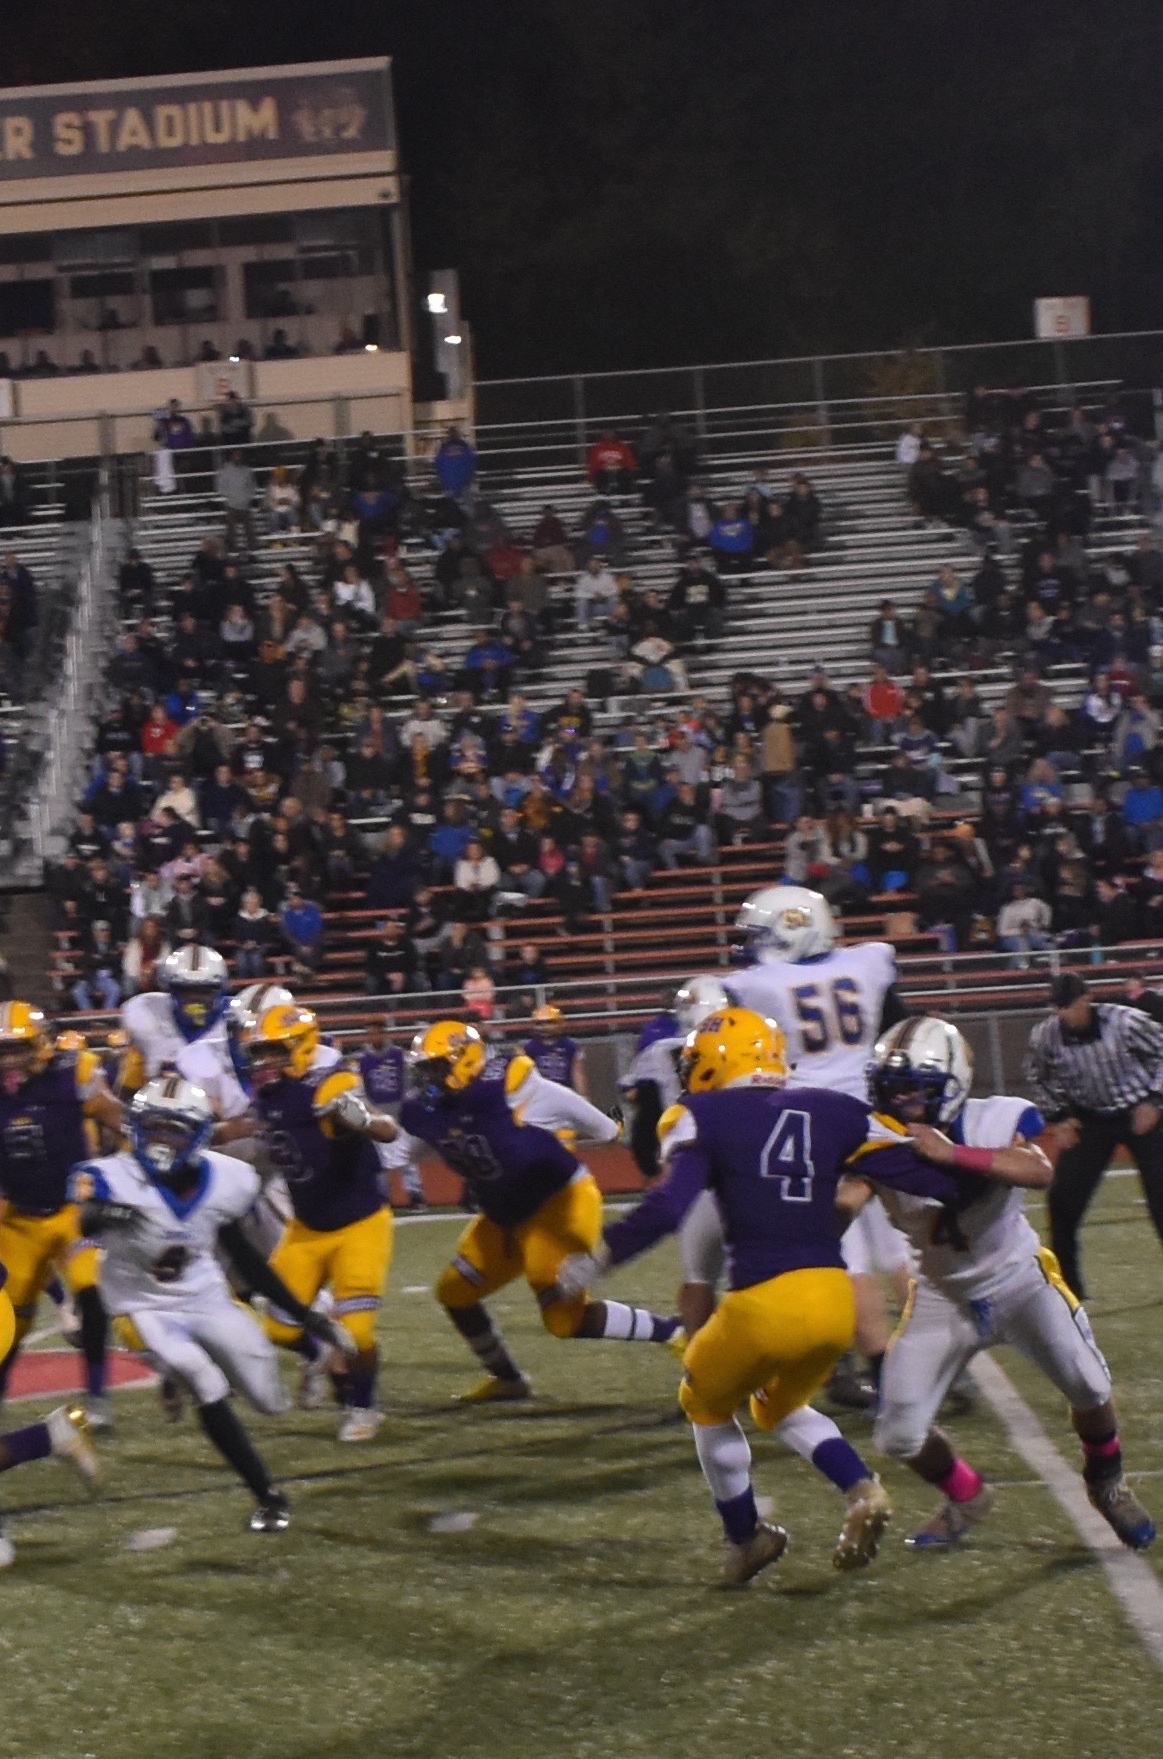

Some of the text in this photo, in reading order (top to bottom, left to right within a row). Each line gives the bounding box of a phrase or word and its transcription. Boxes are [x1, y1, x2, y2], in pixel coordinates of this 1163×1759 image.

[52, 95, 280, 156] STADIUM
[791, 974, 865, 1055] 56
[760, 1108, 815, 1202] 4
